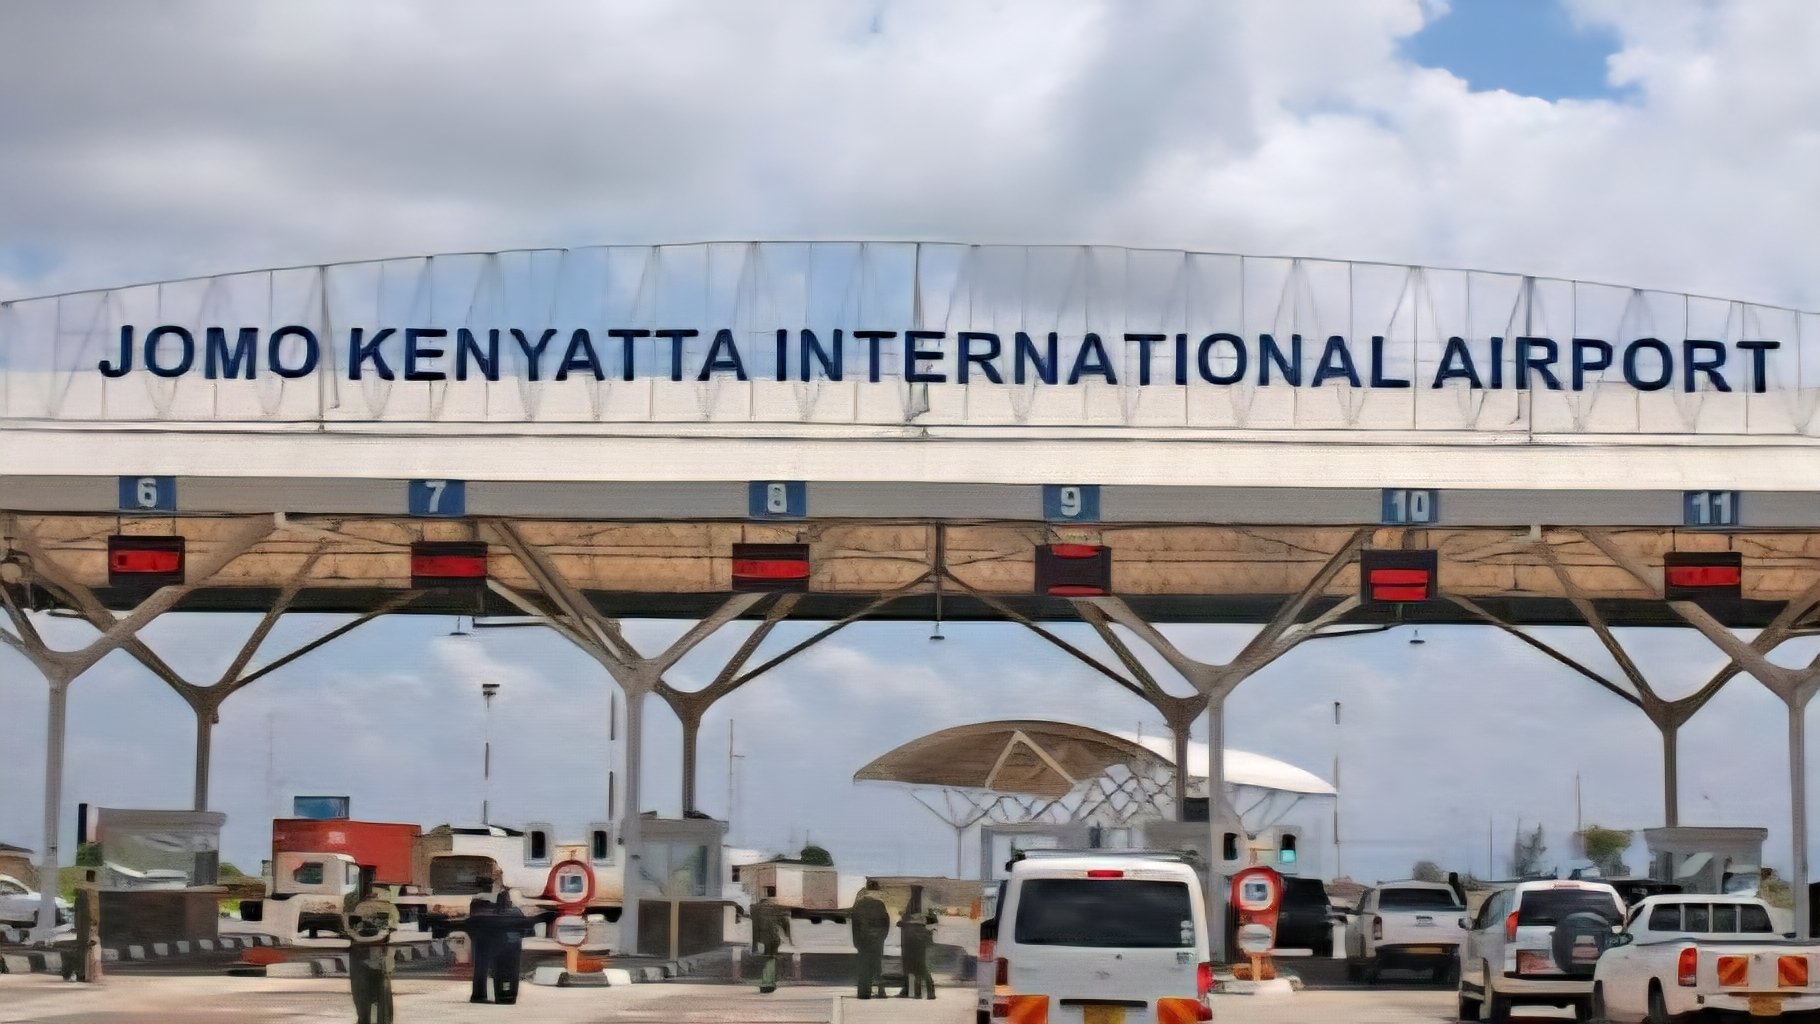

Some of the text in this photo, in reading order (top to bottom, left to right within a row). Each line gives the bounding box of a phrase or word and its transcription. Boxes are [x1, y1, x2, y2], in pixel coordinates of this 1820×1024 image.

[98, 324, 1781, 393] JOMO KENYATTA INTERNATIONAL AIRPORT
[135, 477, 159, 509] 6
[424, 480, 449, 513] 7
[766, 482, 788, 514] 8
[1060, 485, 1083, 517] 9
[1391, 489, 1430, 523] 10
[1693, 490, 1733, 524] 11
